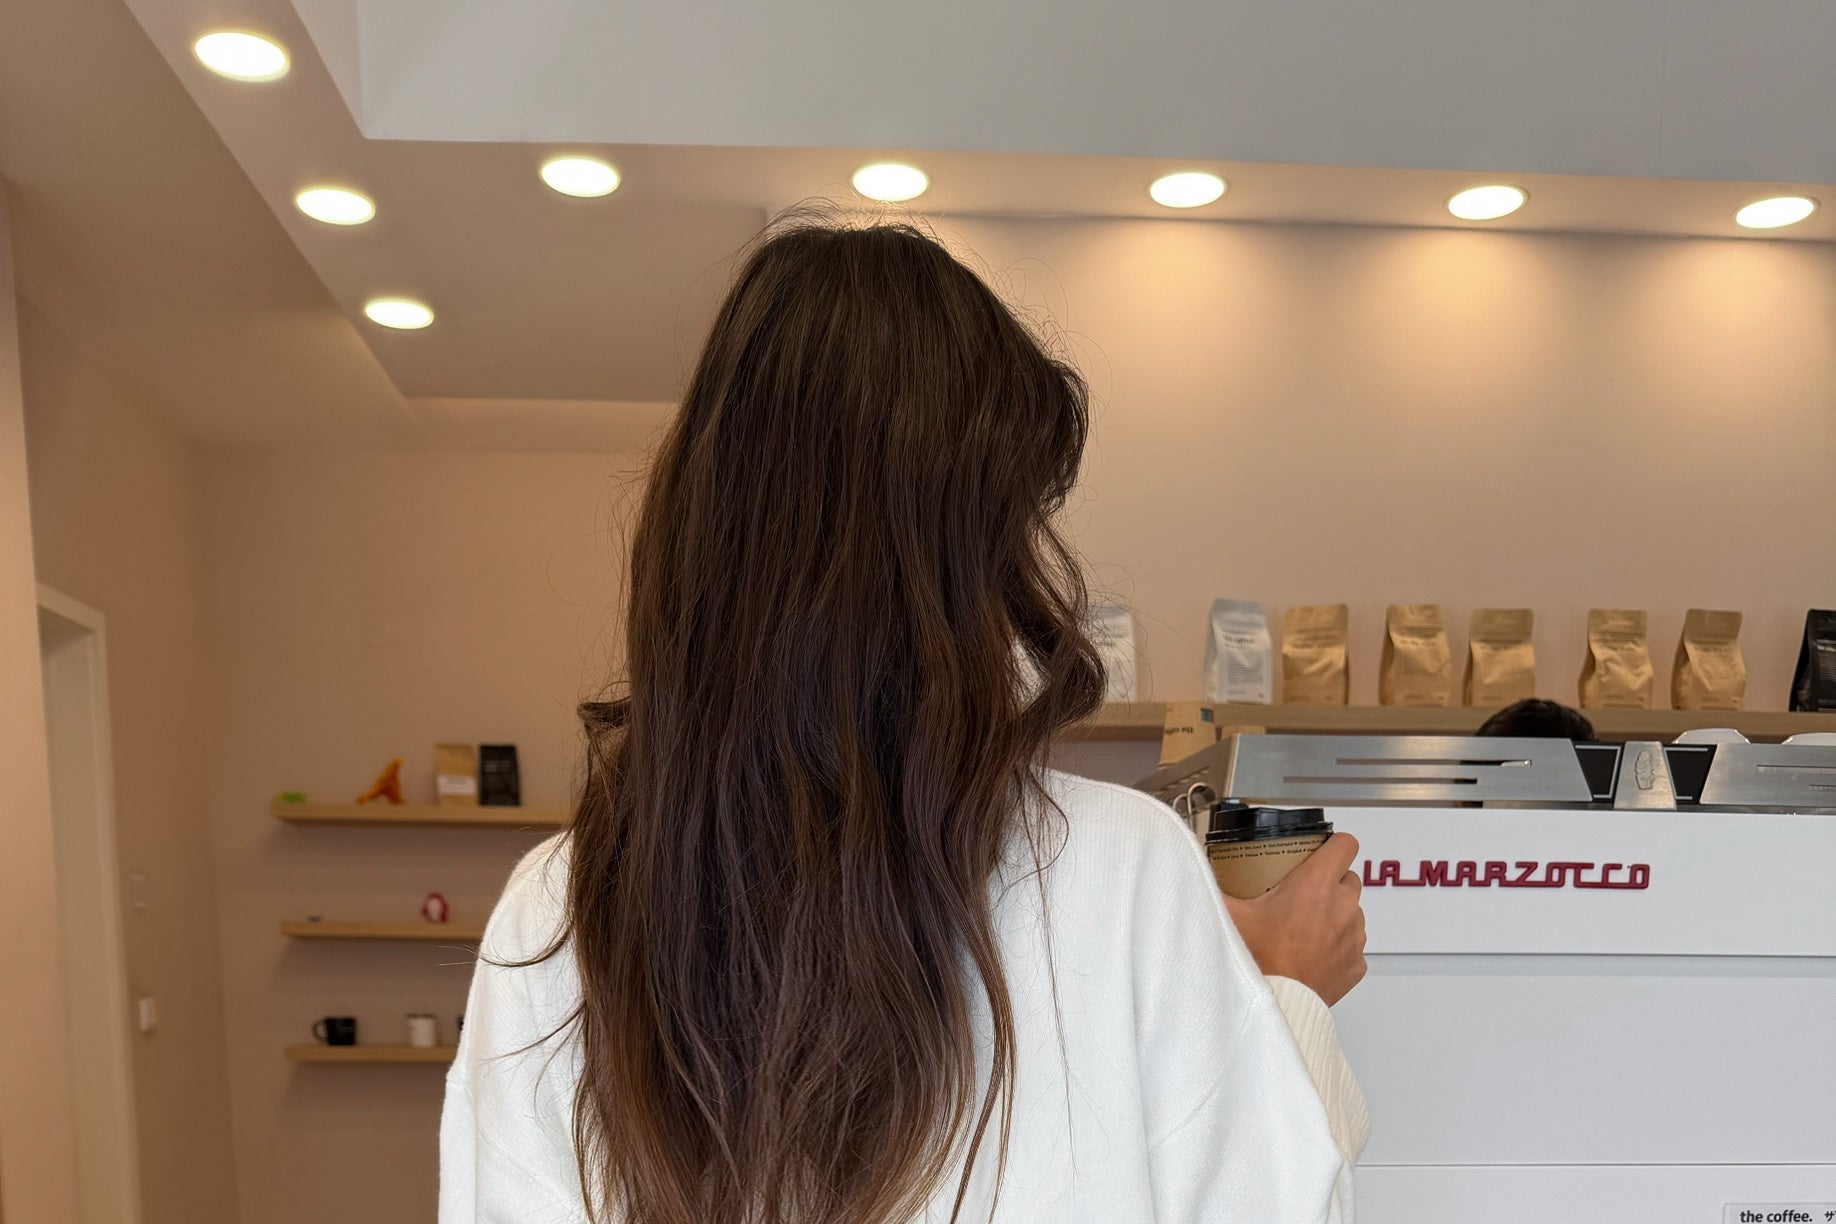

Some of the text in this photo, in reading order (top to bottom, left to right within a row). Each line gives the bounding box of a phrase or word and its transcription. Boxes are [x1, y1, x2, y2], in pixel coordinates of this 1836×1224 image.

[1363, 860, 1400, 887] LA
[1739, 1210, 1763, 1223] the
[1766, 1209, 1813, 1223] coffee.
